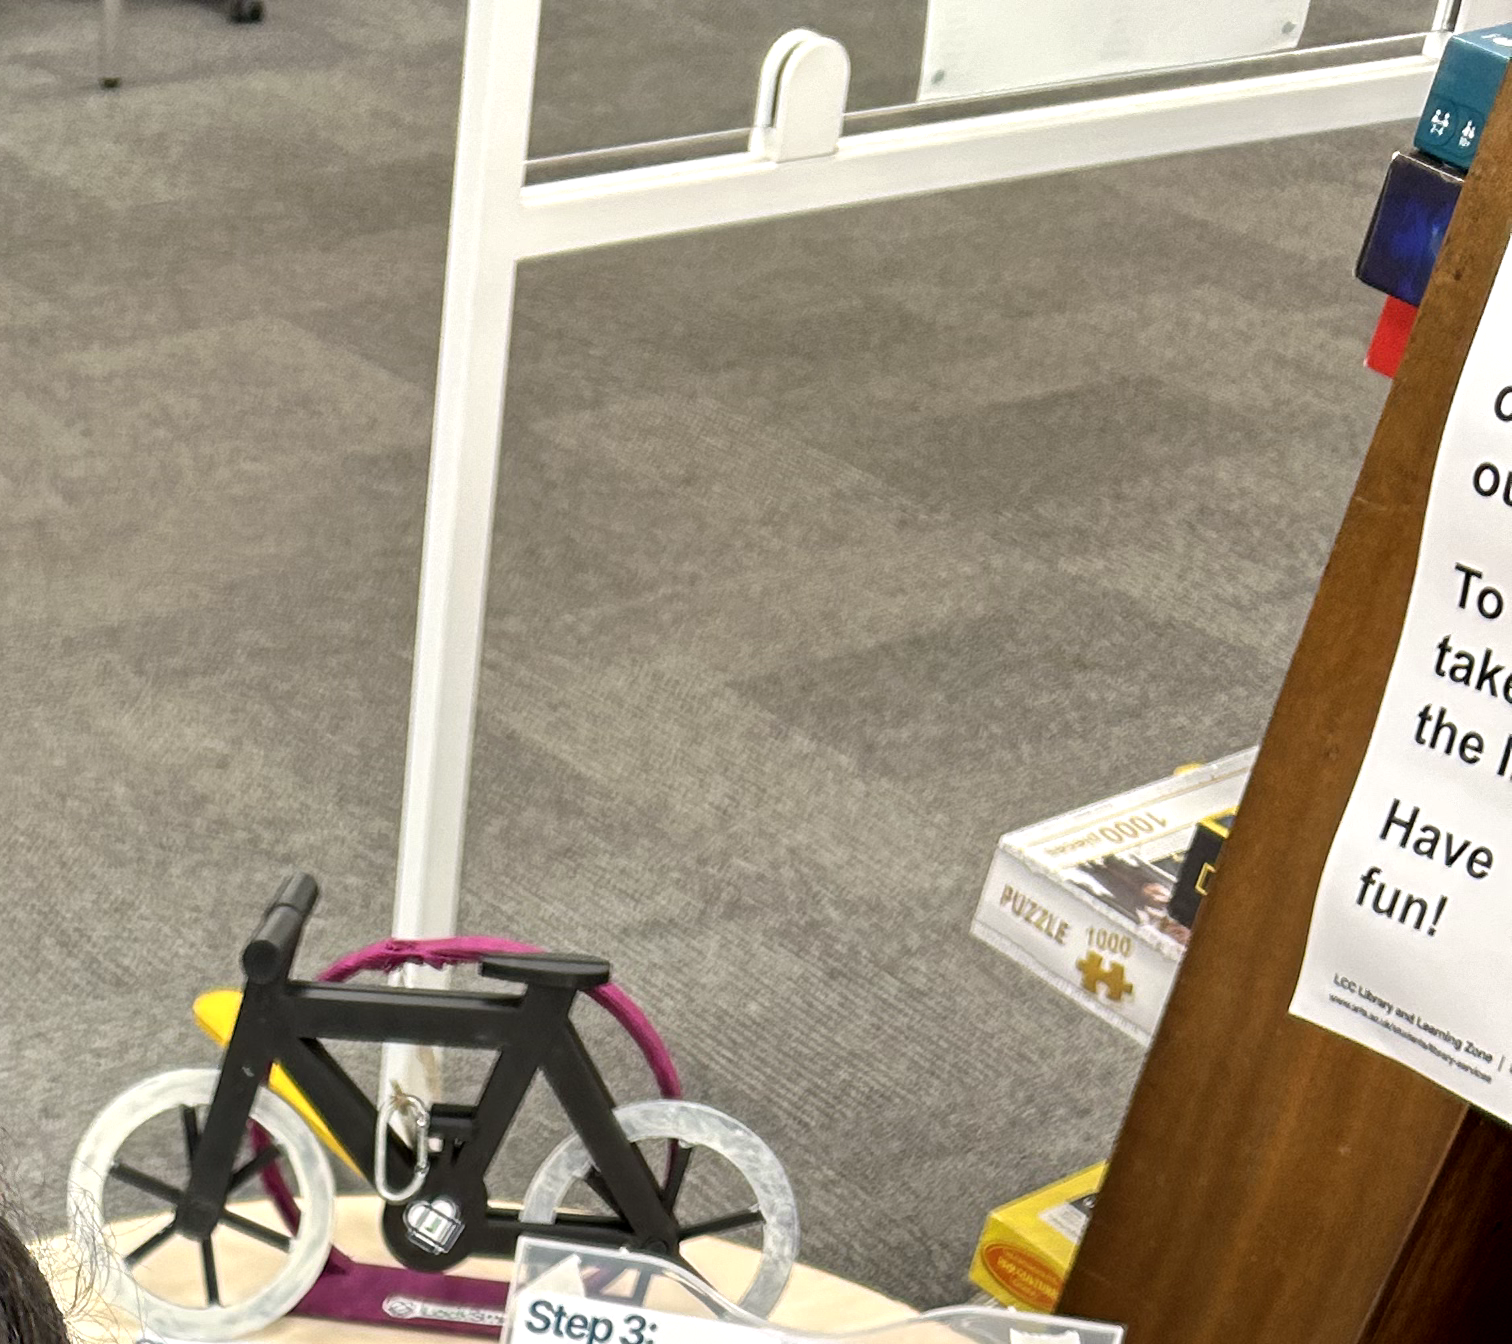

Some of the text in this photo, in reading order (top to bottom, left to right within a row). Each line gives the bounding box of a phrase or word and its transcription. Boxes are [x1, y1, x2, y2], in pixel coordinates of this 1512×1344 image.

[1454, 562, 1504, 619] To
[1414, 703, 1484, 765] the
[1380, 798, 1494, 880] Have
[1000, 884, 1069, 945] PUZZLE
[1355, 866, 1449, 936] fun!
[1087, 925, 1131, 957] 1000
[1333, 972, 1493, 1064] LCC Library and Learning Zone
